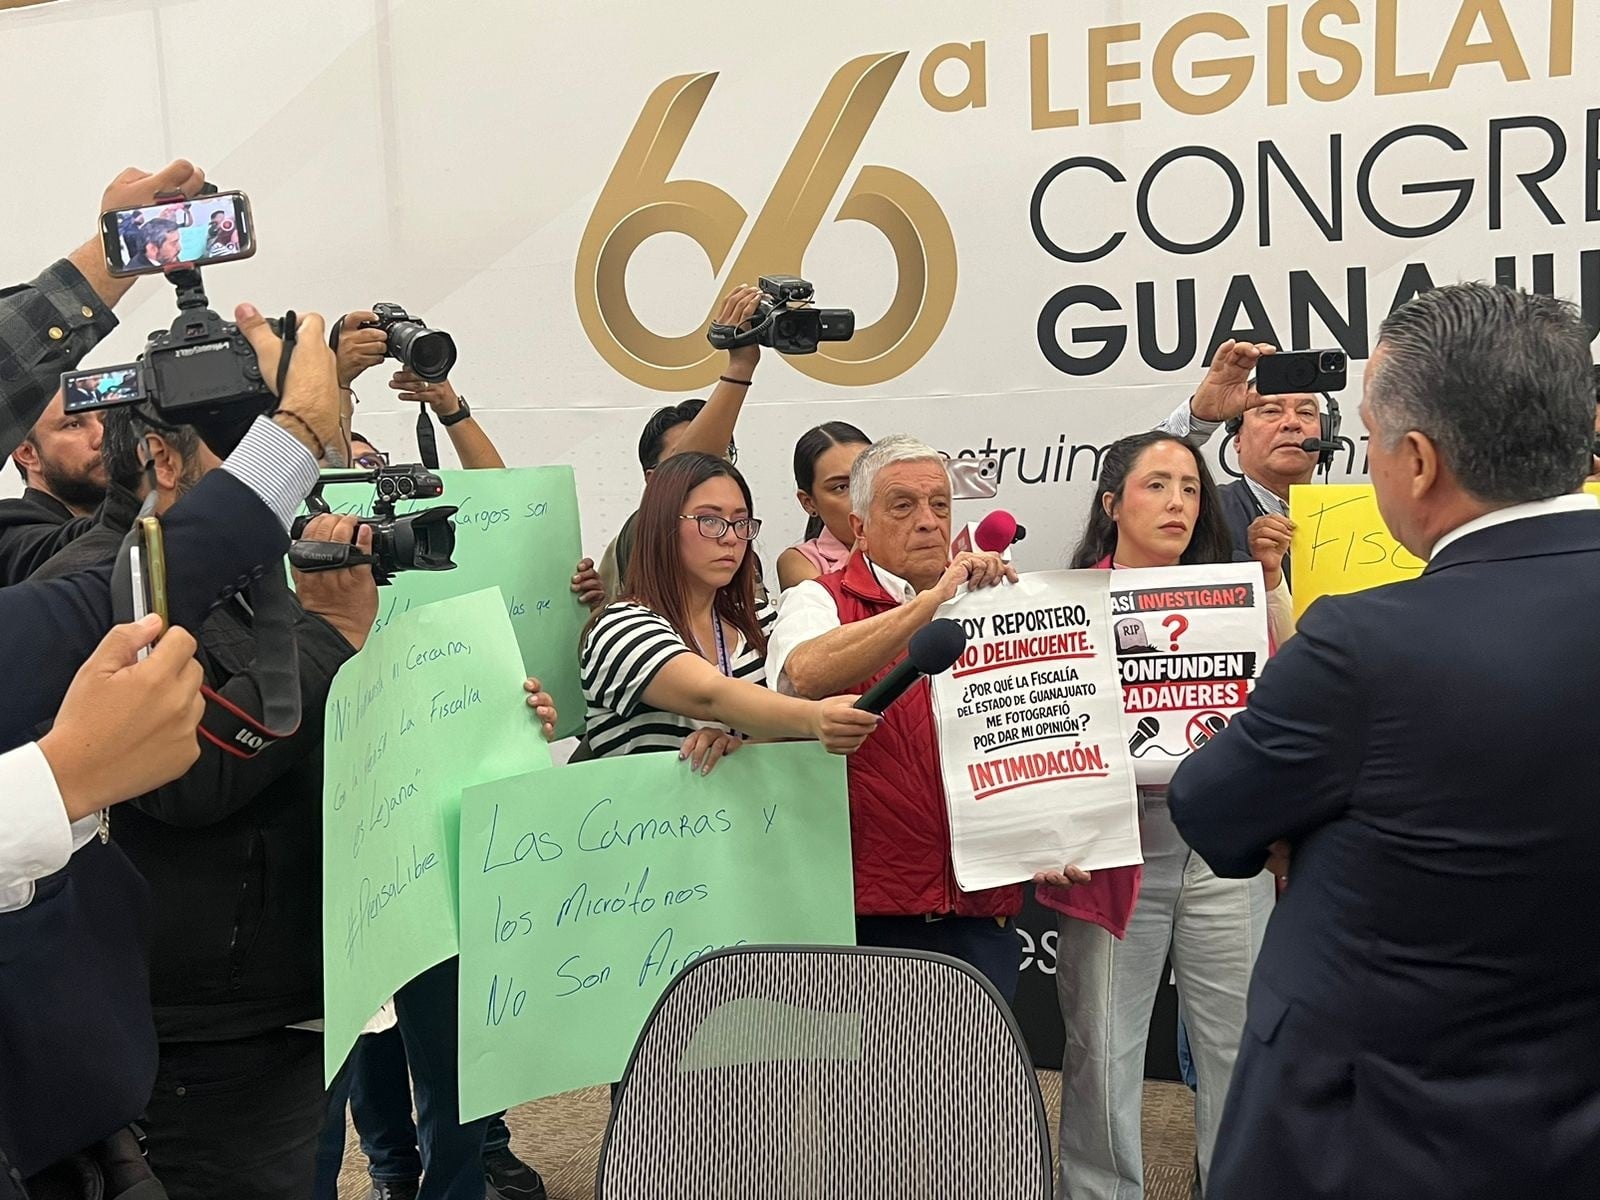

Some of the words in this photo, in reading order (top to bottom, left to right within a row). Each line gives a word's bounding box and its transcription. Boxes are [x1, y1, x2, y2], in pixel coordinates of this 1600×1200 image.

[1030, 108, 1600, 263] CONGR
[1138, 586, 1248, 610] INVESTIGAN?
[953, 616, 986, 640] OY
[992, 605, 1091, 637] REPORTERO,
[1123, 625, 1140, 637] RIP
[983, 631, 1095, 665] DELINCUENTE.
[957, 707, 974, 719] DEL
[975, 697, 1013, 714] ESTADO
[1014, 694, 1027, 706] DE
[1029, 683, 1097, 704] GUANAJUATO
[994, 675, 1015, 694] QUÉ
[1015, 676, 1030, 690] LA
[973, 732, 997, 750] POR
[997, 727, 1020, 743] DAR
[1021, 725, 1034, 739] MI
[1035, 713, 1091, 737] OPINIÓN?
[986, 715, 1003, 729] ME
[1005, 700, 1071, 725] FOTOGRAFIÓ
[967, 740, 1110, 792] INTIMIDACIÓN.
[483, 803, 563, 874] Las
[486, 974, 527, 1027] No
